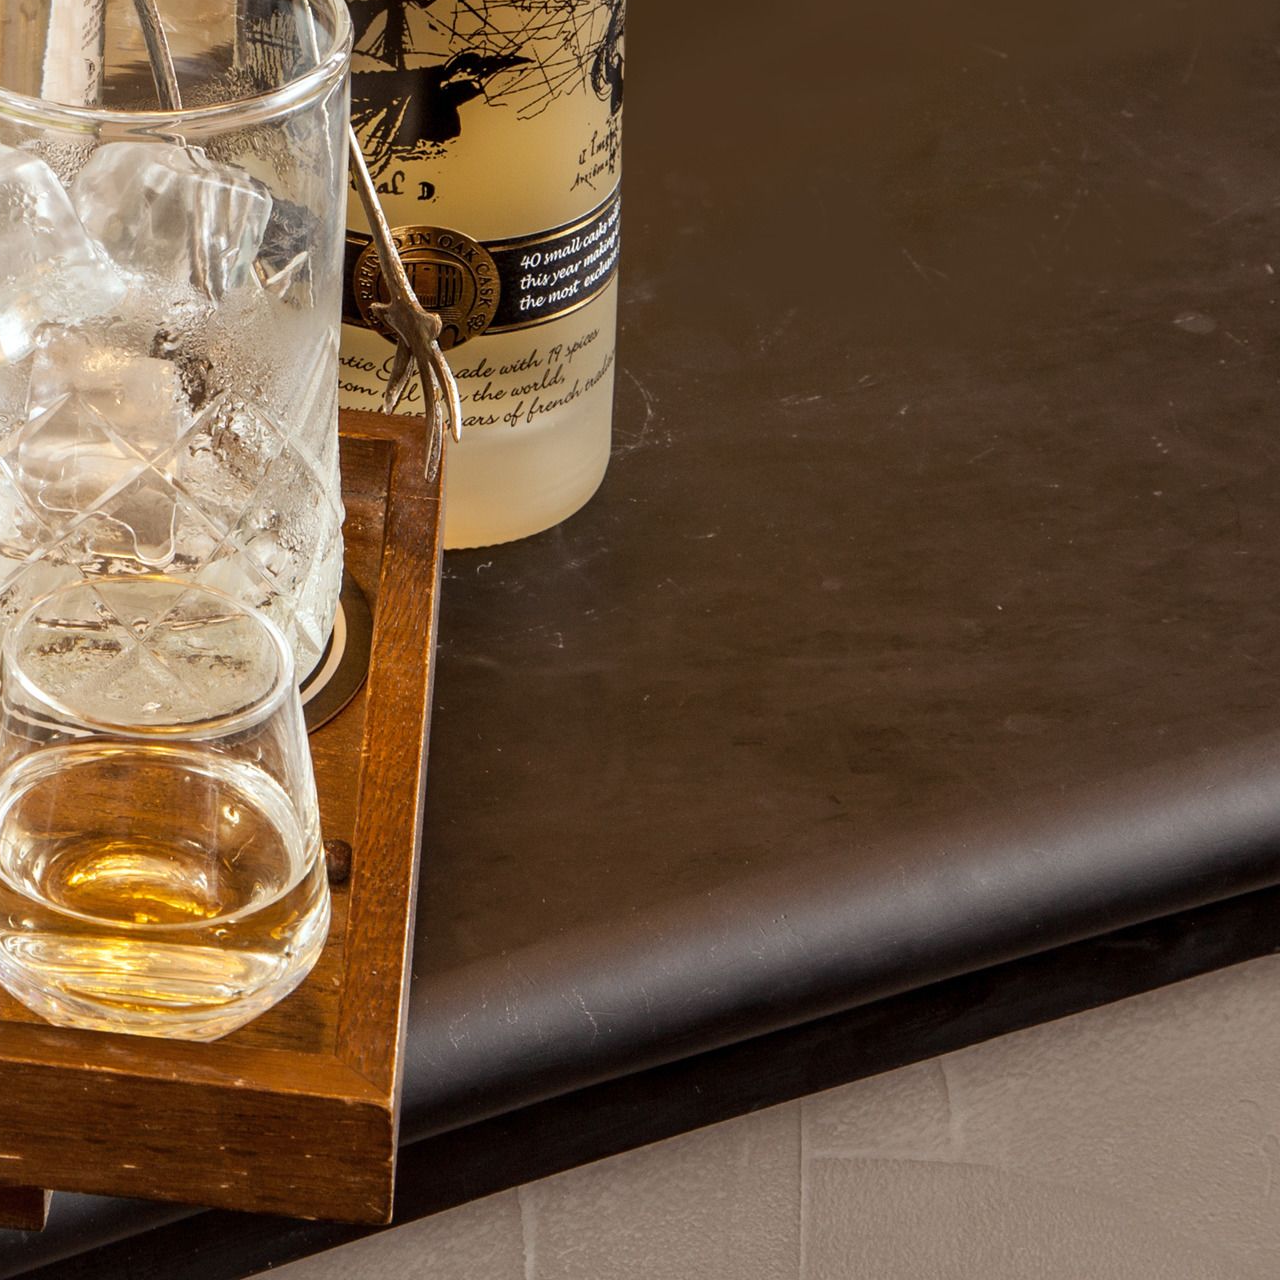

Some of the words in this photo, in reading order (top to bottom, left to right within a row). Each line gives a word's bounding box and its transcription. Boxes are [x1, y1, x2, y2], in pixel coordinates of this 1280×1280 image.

[520, 252, 542, 269] 40
[544, 236, 584, 265] small
[583, 221, 608, 248] casks
[407, 233, 431, 247] IN
[438, 235, 480, 264] OAK
[474, 262, 494, 309] CASK
[520, 273, 552, 290] this
[550, 260, 583, 287] year
[520, 294, 547, 311] the
[548, 279, 581, 303] most
[454, 357, 497, 379] ade
[499, 349, 543, 375] with
[548, 343, 563, 364] 19
[565, 328, 600, 364] spices
[473, 381, 507, 403] the
[511, 364, 566, 397] world,
[503, 401, 525, 428] of
[527, 380, 583, 424] french
